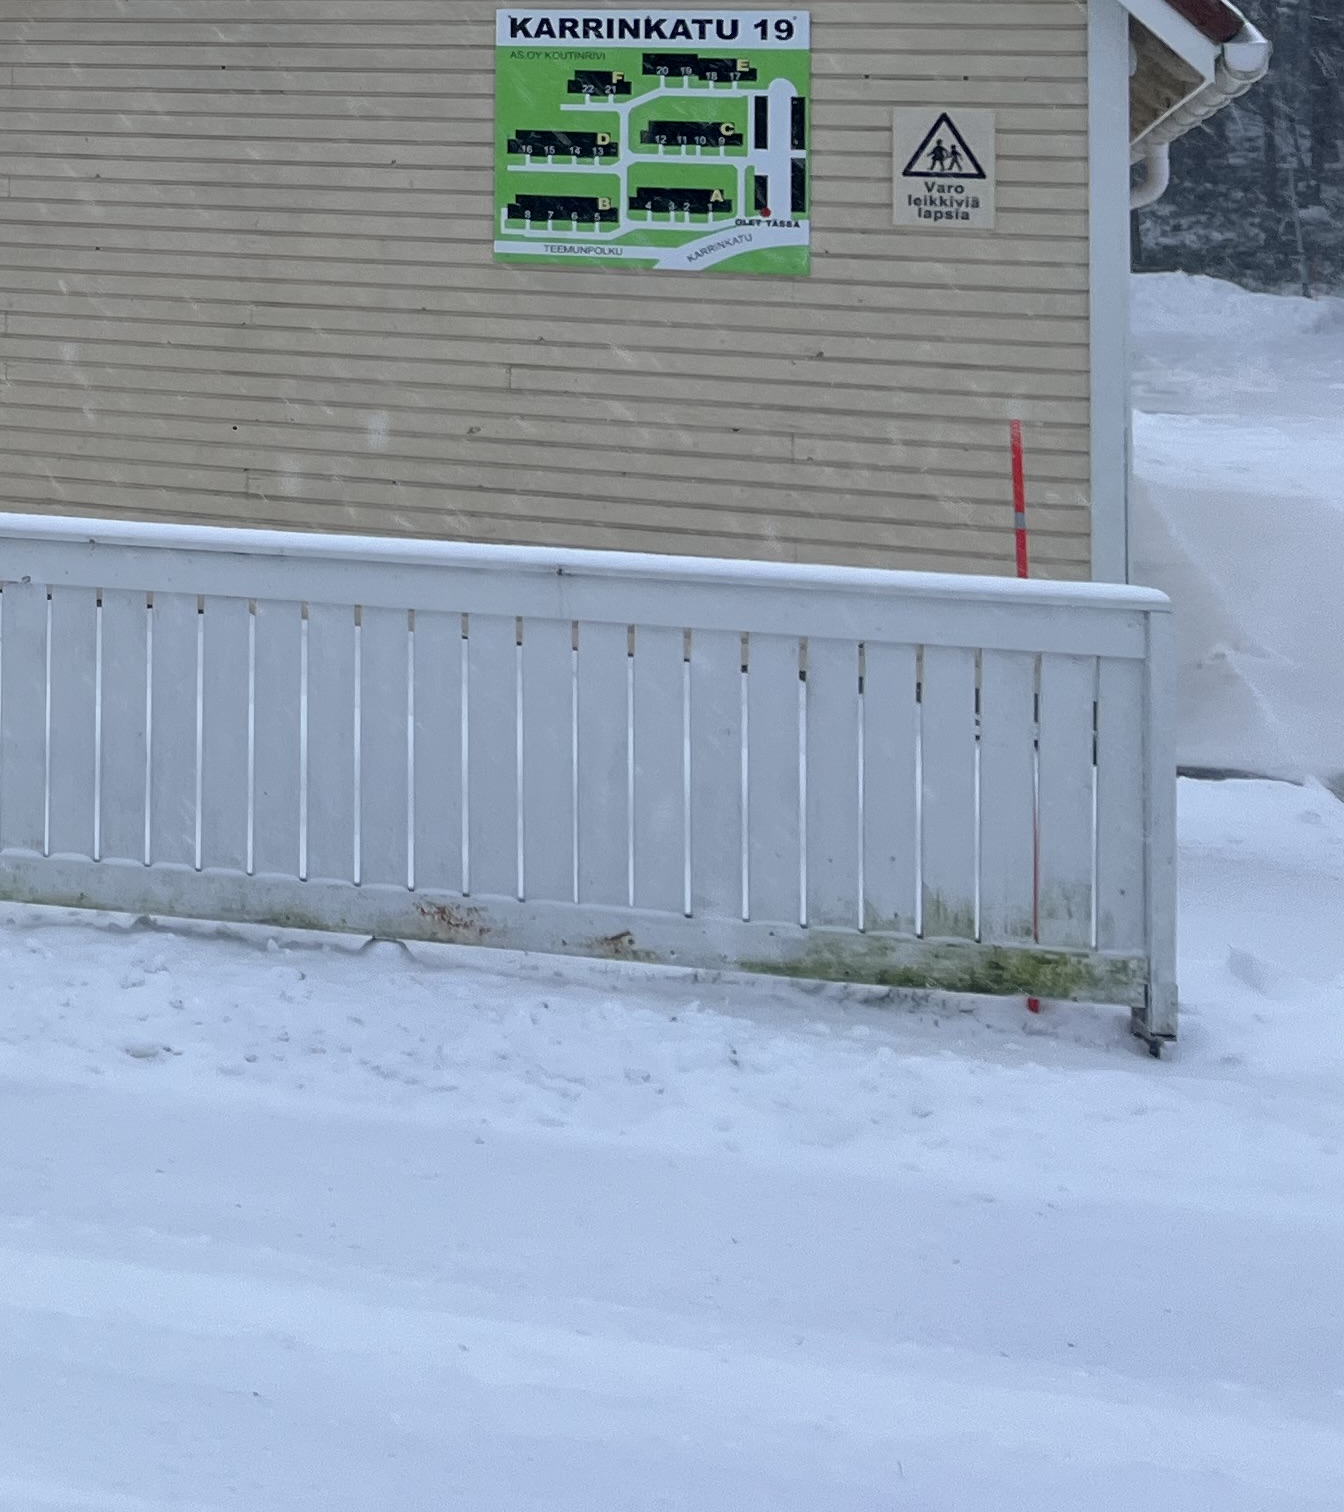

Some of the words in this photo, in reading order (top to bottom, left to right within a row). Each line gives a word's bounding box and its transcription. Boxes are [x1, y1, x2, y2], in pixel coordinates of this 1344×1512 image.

[510, 17, 739, 40] KARRINKATU
[754, 18, 795, 41] 19
[737, 59, 750, 72] E
[613, 71, 624, 84] F
[656, 66, 669, 76] 20
[681, 66, 693, 76] 19
[706, 71, 718, 81] 18
[730, 72, 741, 81] 17
[583, 84, 595, 94] 22
[605, 84, 616, 94] 21
[721, 122, 735, 136] C
[597, 133, 611, 146] D
[655, 135, 667, 144] 12
[677, 135, 688, 144] 11
[695, 136, 707, 145] 10
[718, 137, 726, 146] 9
[522, 145, 533, 155] 16
[544, 145, 555, 155] 15
[569, 146, 581, 155] 14
[592, 147, 604, 156] 13
[924, 181, 964, 194] Varo
[710, 189, 724, 202] A
[598, 197, 611, 210] B
[644, 201, 652, 210] 4
[683, 202, 690, 211] 2
[547, 210, 554, 220] 7
[571, 211, 578, 221] 6
[593, 212, 601, 222] 5
[918, 207, 969, 222] lapsia
[735, 218, 762, 227] OLET
[543, 244, 623, 256] TEEMUNPOLKU
[687, 233, 753, 263] KARRINKATU
